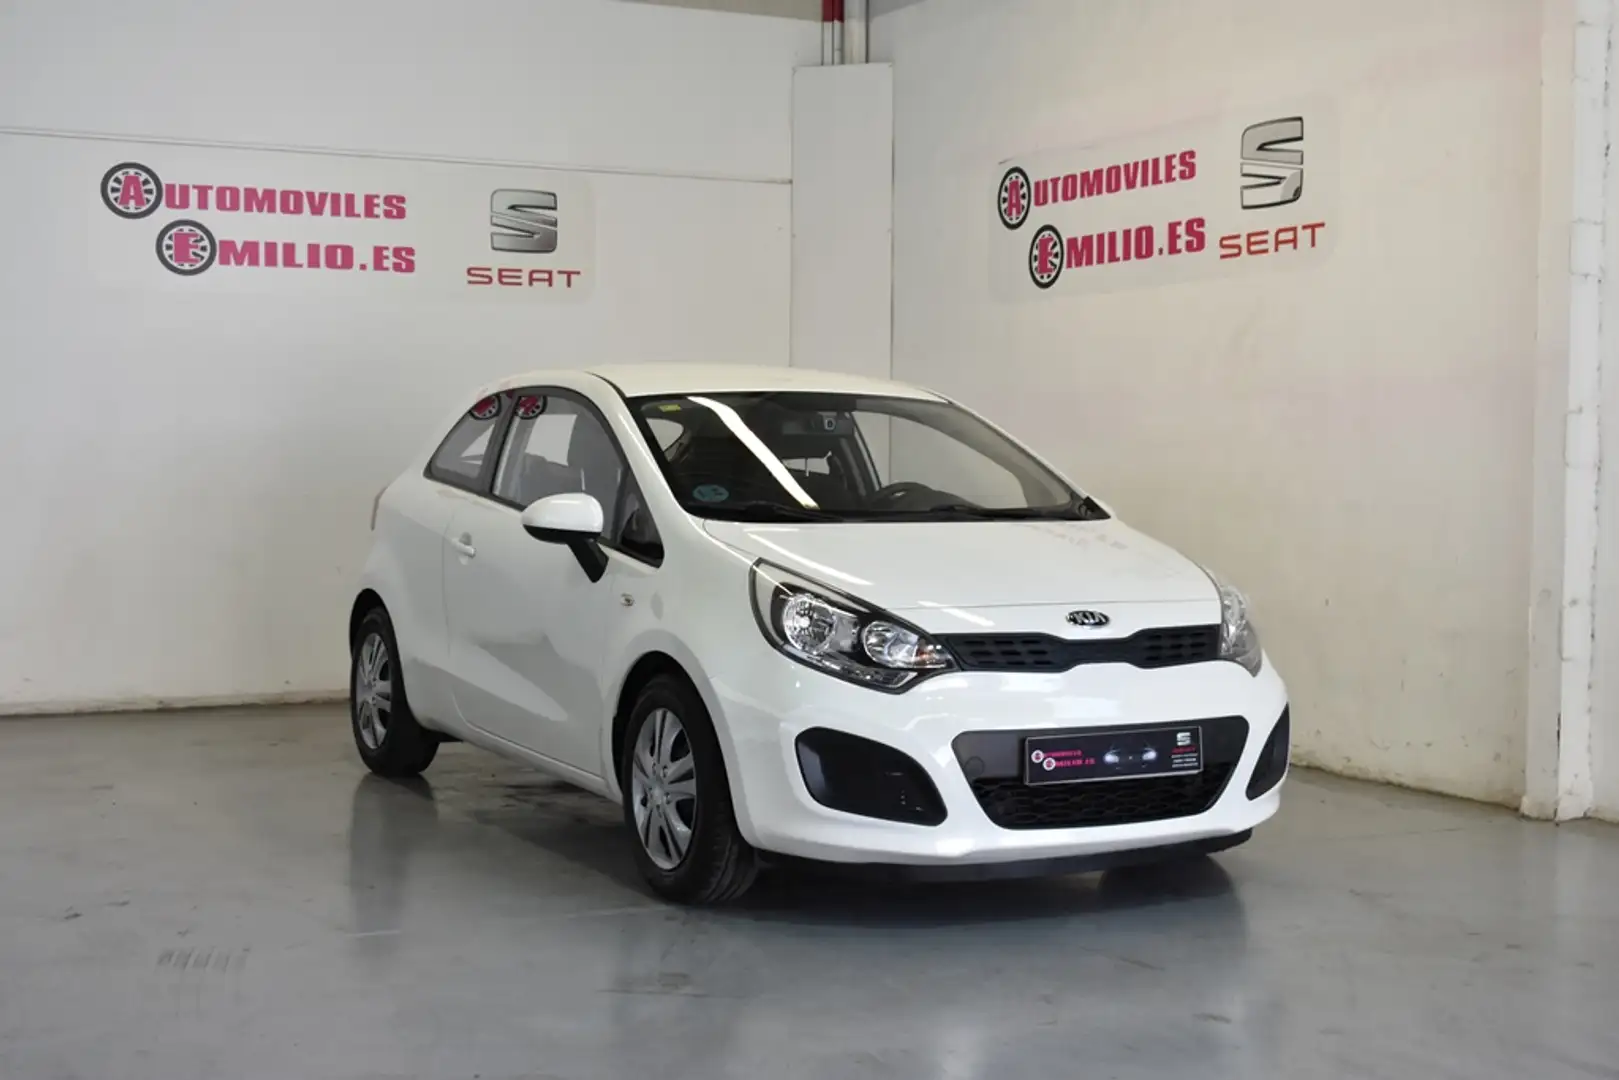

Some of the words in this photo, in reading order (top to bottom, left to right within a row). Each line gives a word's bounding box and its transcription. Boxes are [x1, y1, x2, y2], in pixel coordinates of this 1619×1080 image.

[117, 174, 408, 221] AUTOMOVILES
[1006, 150, 1197, 217] AUTOMOVILES
[172, 231, 417, 275] EMILIO.ES
[1036, 217, 1206, 275] EMILIO.ES
[1218, 221, 1326, 260] SEAT
[466, 266, 582, 289] SEAT
